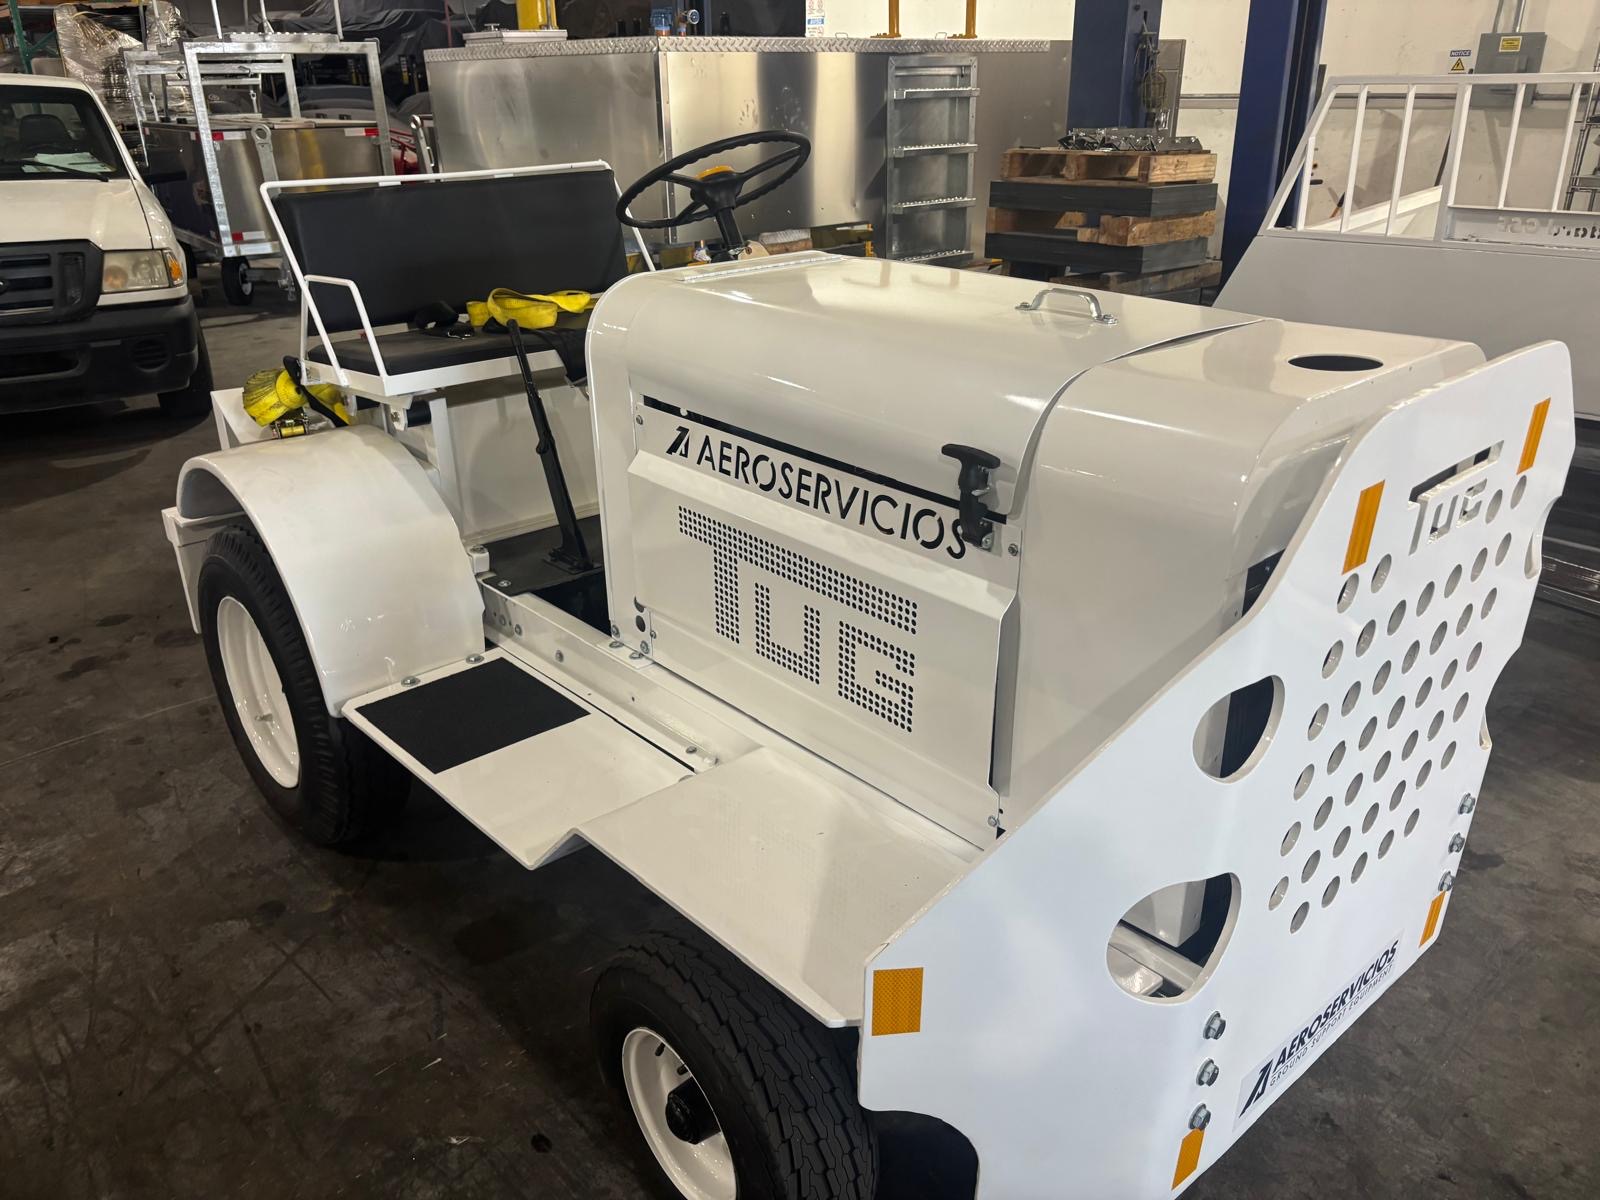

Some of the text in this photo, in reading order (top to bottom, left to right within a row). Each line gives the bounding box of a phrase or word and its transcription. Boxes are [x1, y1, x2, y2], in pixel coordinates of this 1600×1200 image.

[697, 435, 966, 559] AEROSERVICIOS
[1407, 440, 1504, 556] TUG
[678, 505, 918, 733] TUG
[1270, 1047, 1308, 1087] GROUND
[1311, 1008, 1347, 1048] SUPPORT
[1273, 940, 1398, 1074] AEROSERVICIOS
